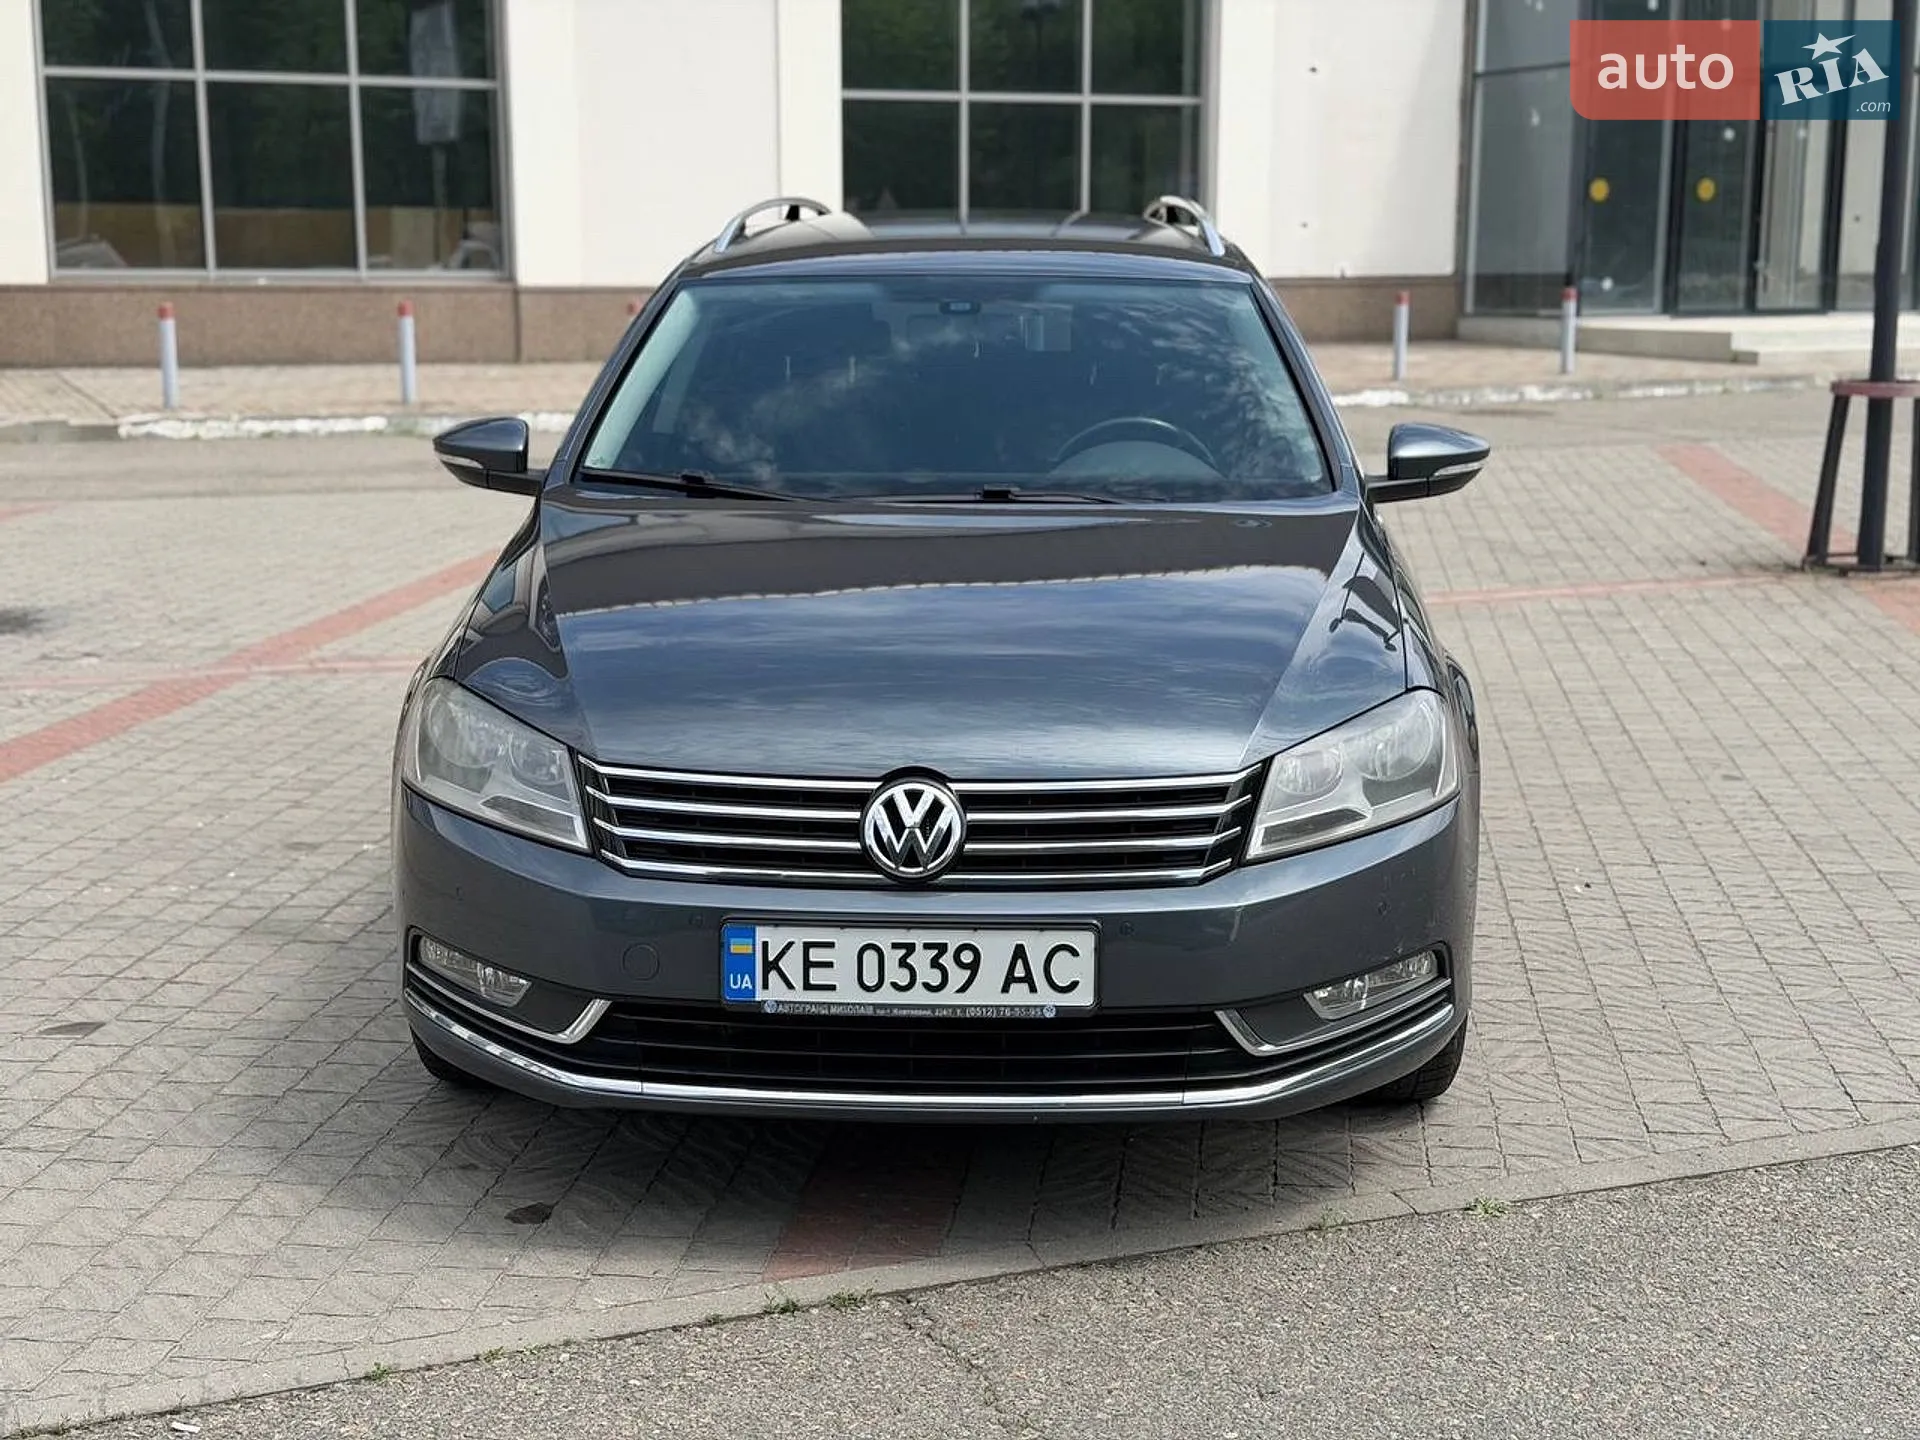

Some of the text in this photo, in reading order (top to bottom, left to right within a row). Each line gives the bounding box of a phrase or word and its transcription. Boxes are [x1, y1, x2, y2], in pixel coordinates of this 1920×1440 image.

[729, 973, 752, 989] UA
[761, 940, 1081, 994] KE 0339 AC
